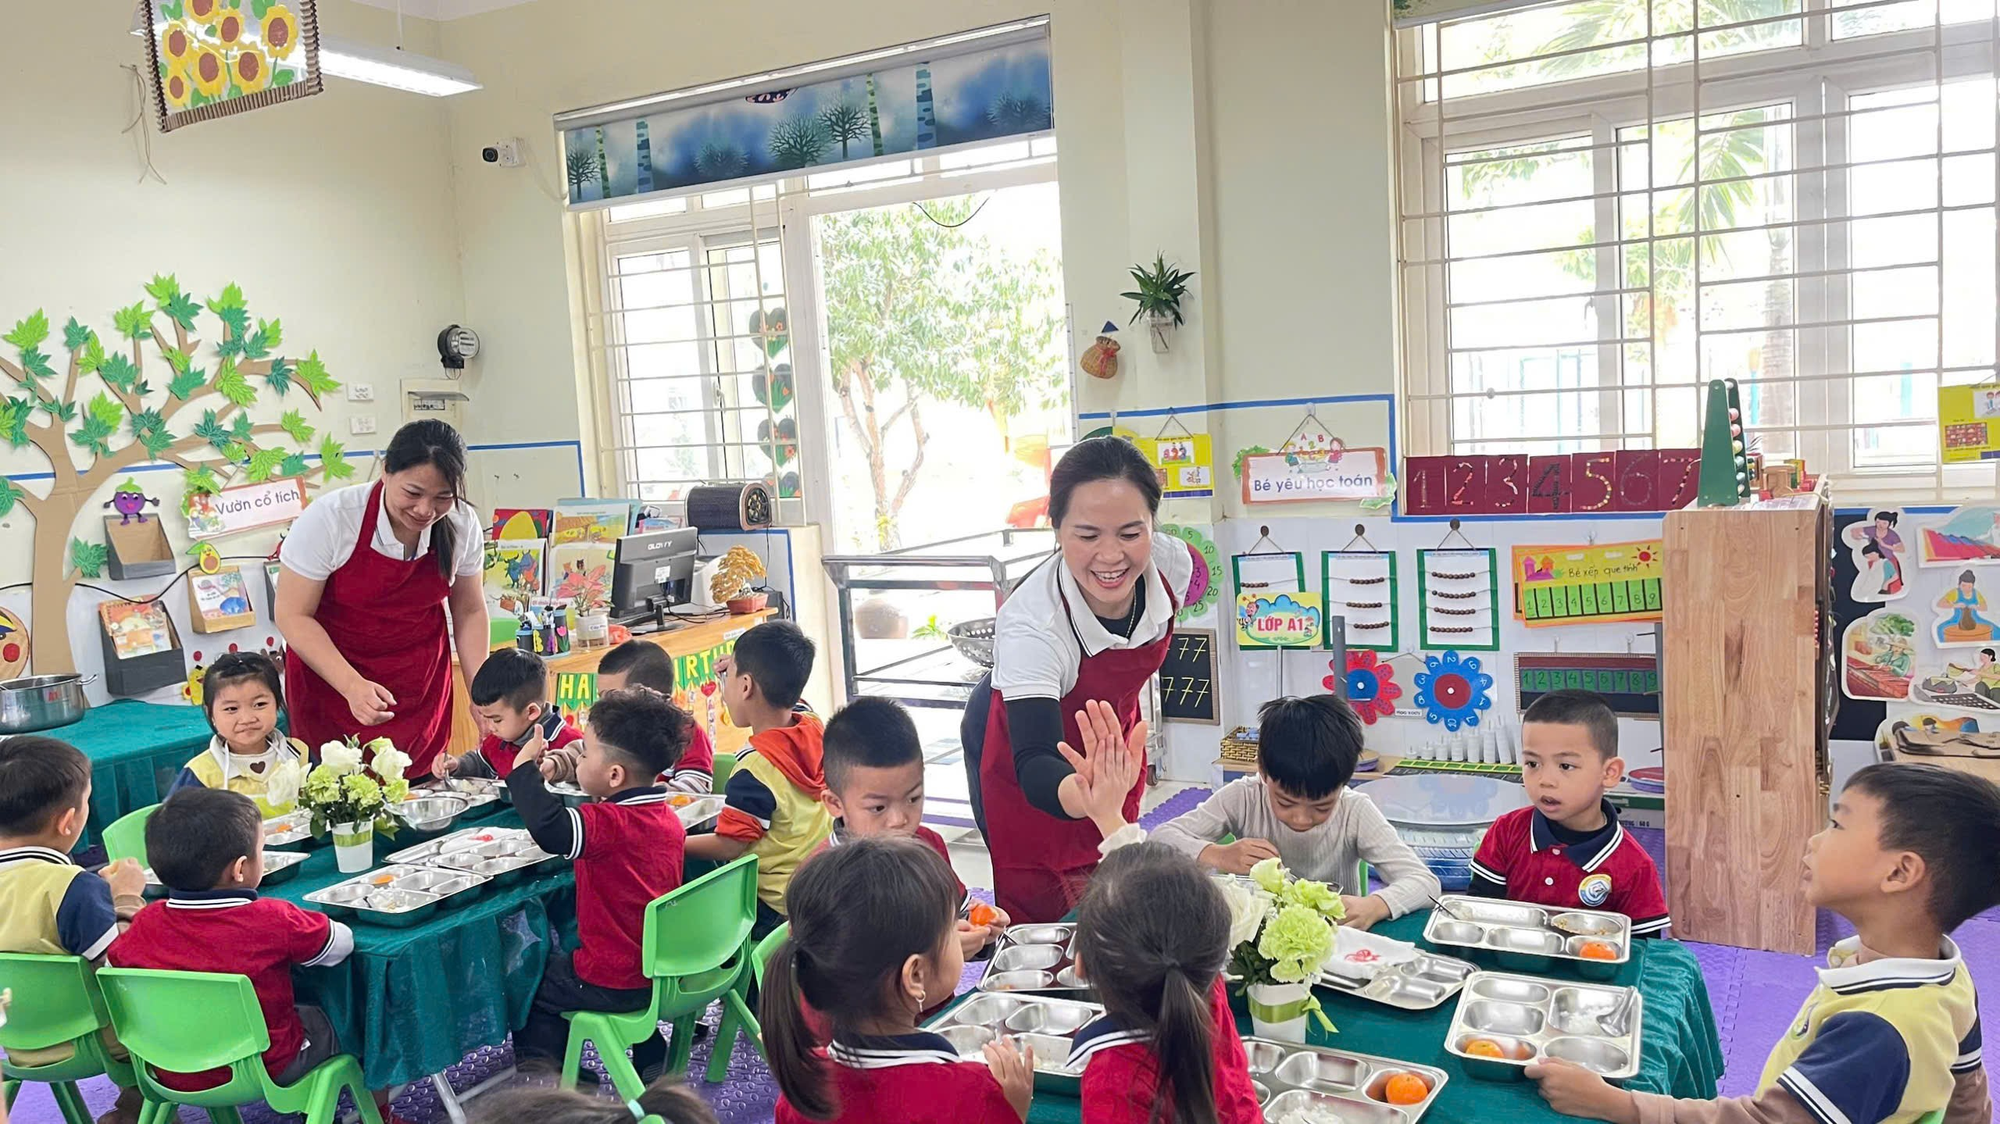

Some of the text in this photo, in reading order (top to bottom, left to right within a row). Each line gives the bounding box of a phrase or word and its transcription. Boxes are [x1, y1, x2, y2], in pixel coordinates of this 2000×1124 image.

[1254, 474, 1373, 492] Bé yêu học toán
[1453, 462, 1475, 505] 2
[1495, 458, 1518, 507] 3
[1532, 463, 1571, 509] 4
[1581, 457, 1612, 510] 5
[1663, 457, 1702, 505] 7
[215, 489, 300, 515] Vườn cổ tích
[1204, 545, 1215, 554] 10
[1212, 565, 1223, 576] 15
[1604, 567, 1621, 576] que
[1207, 586, 1218, 596] 20
[1193, 602, 1204, 613] 25
[1257, 615, 1303, 631] LỚP A1
[560, 674, 590, 700] HA
